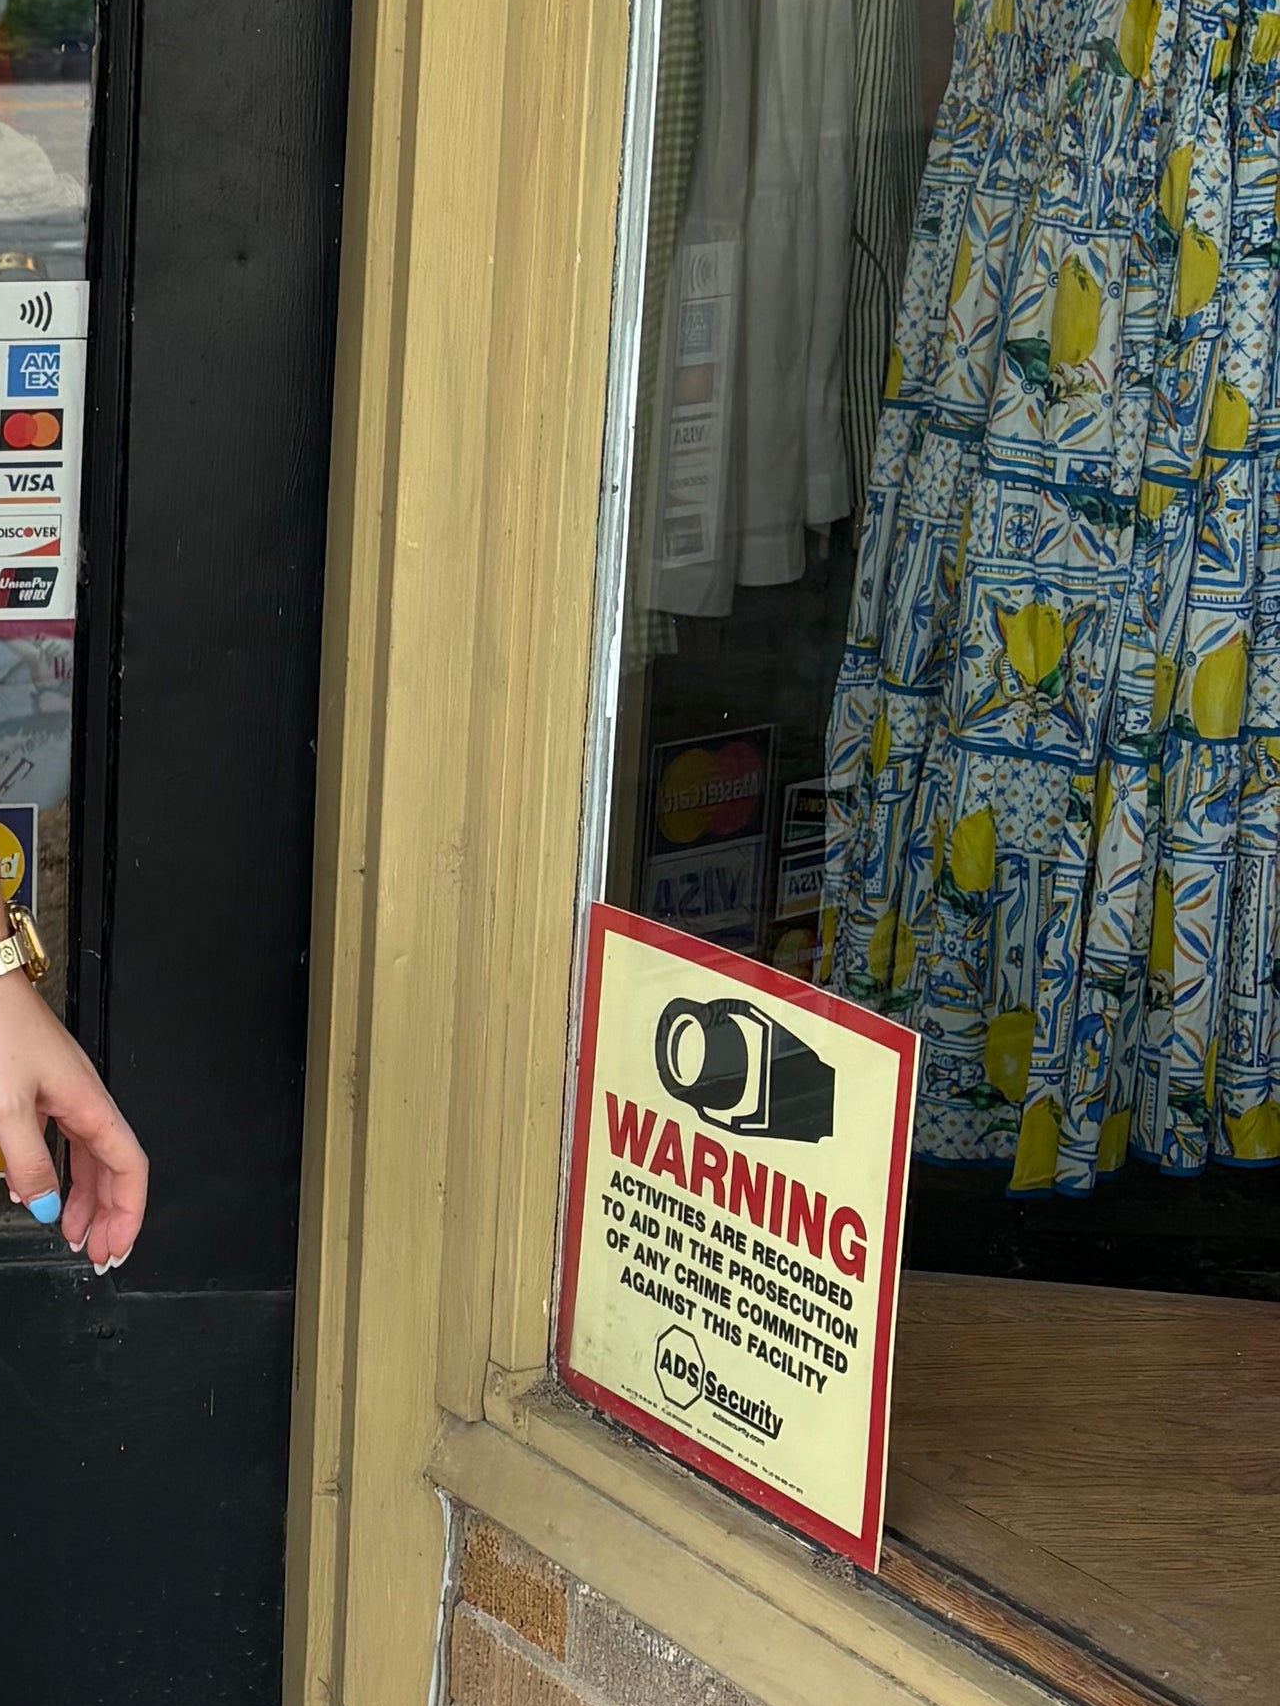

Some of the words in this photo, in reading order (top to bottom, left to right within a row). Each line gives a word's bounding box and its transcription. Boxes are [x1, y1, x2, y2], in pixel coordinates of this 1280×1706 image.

[20, 352, 60, 372] AM
[25, 371, 59, 389] EX
[4, 474, 55, 492] VISA
[0, 576, 53, 596] UnionPay
[605, 1090, 868, 1284] WARNING
[610, 1170, 706, 1233] ACTIVITIES
[710, 1220, 747, 1255] ARE
[752, 1239, 853, 1311] RECORDED
[601, 1193, 625, 1222] TO
[629, 1210, 660, 1239] AID
[665, 1226, 683, 1253] IN
[689, 1238, 724, 1274] THE
[728, 1259, 858, 1349] PROSECUTION
[606, 1228, 630, 1253] OF
[633, 1242, 671, 1275] ANY
[674, 1263, 732, 1310] CRIME
[737, 1297, 848, 1374] COMMITTED
[620, 1266, 697, 1321] AGAINST
[702, 1307, 742, 1346] THIS
[747, 1333, 828, 1394] FACILITY
[660, 1348, 699, 1388] ADS
[705, 1371, 784, 1439] Security
